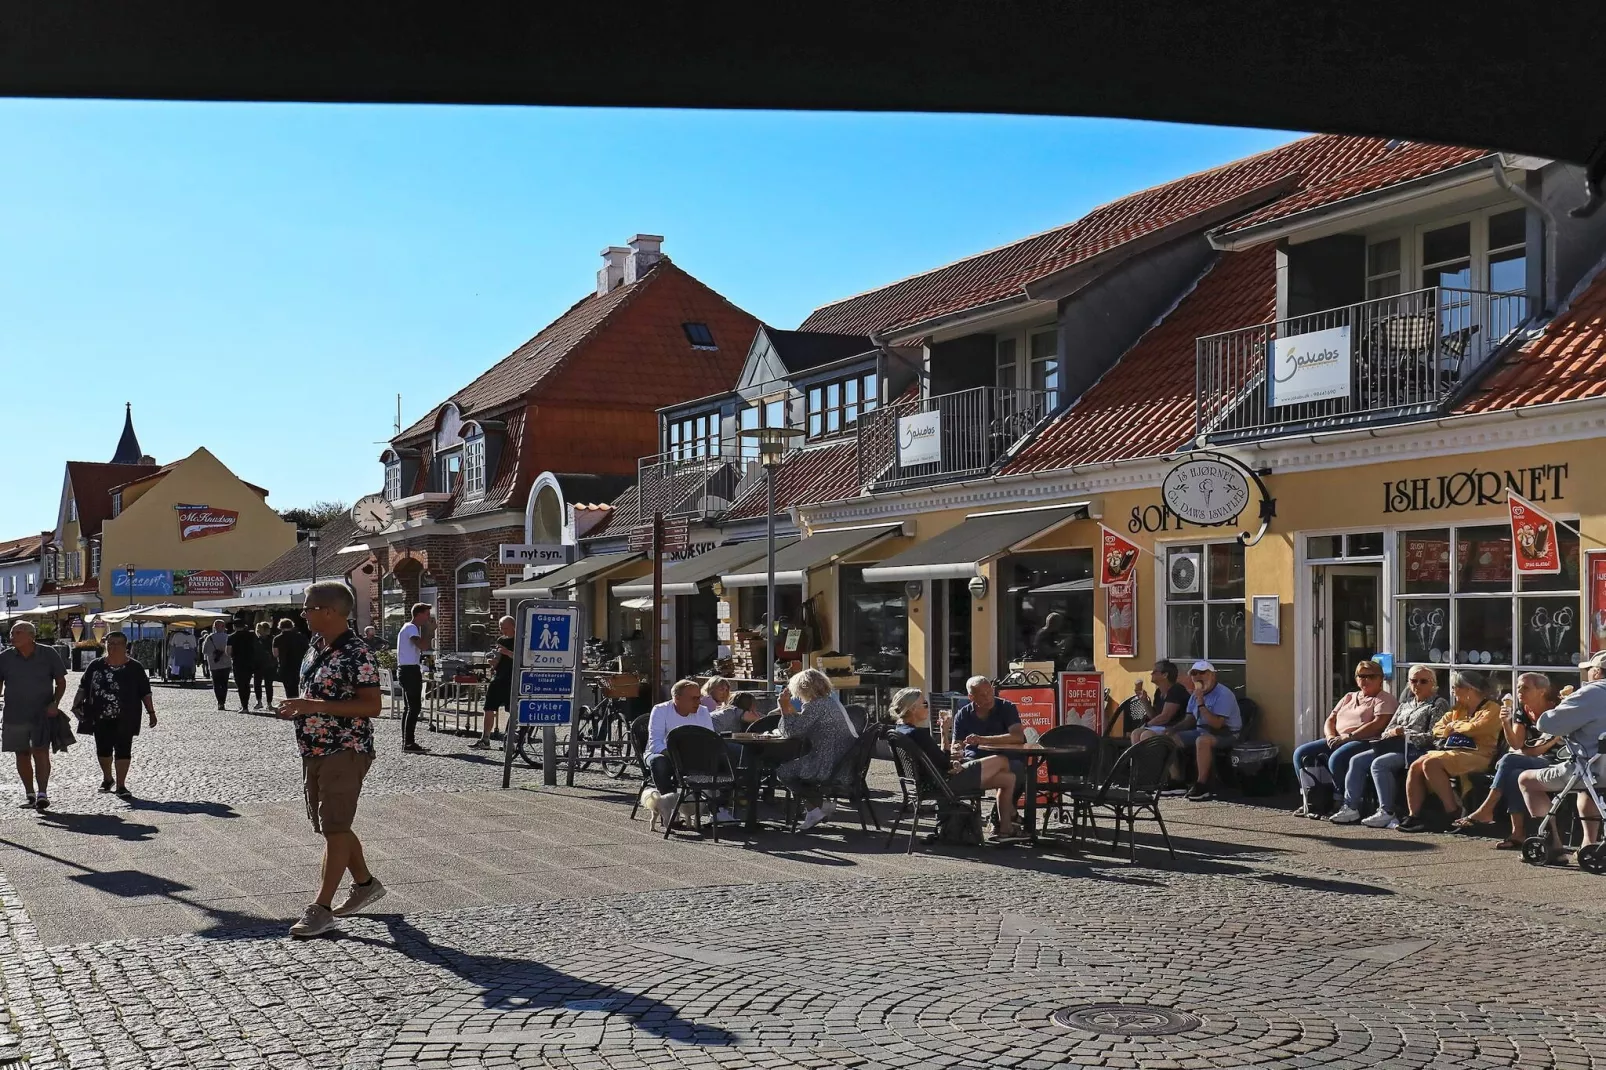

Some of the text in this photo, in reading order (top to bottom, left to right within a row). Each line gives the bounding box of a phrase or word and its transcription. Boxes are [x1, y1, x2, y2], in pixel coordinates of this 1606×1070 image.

[1275, 348, 1339, 383] Jakobs
[900, 425, 935, 449] Jakobs
[1177, 466, 1236, 483] IS HJØRNET
[1383, 463, 1568, 513] ISHJØRNET
[1180, 502, 1206, 519] DAWS
[1209, 489, 1246, 520] ISVAFLER
[520, 549, 562, 560] nyt syn.
[115, 573, 165, 587] Dessert
[534, 655, 563, 663] Zone
[1068, 689, 1097, 699] SOFT-ICE
[529, 702, 563, 711] Cykler
[529, 713, 562, 721] tilladt
[1032, 717, 1051, 726] VAFFEL
